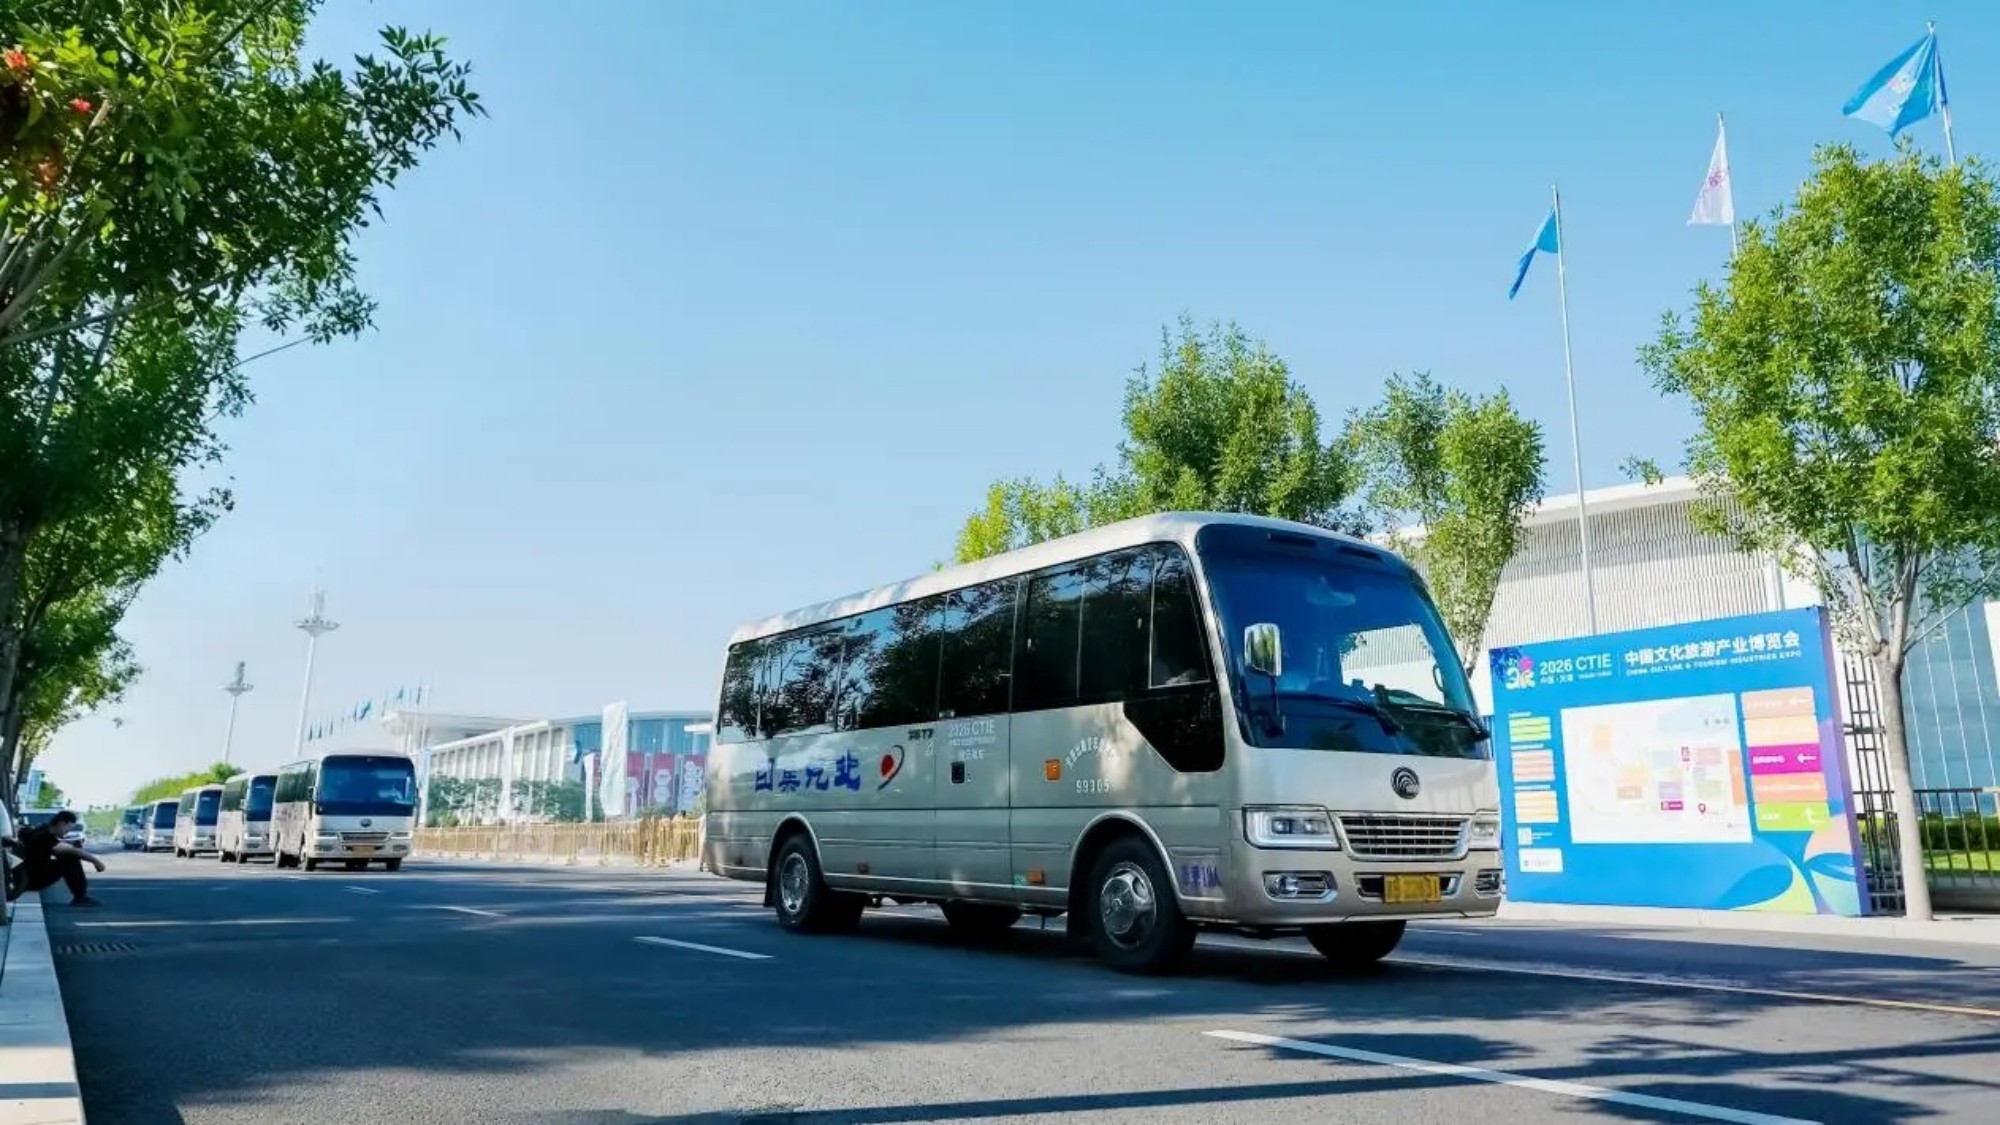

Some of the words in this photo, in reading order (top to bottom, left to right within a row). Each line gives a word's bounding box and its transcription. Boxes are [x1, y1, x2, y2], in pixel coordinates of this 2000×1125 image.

[1624, 630, 1800, 667] 中国文化旅游产业博览会
[1779, 649, 1802, 660] EXPO
[1540, 658, 1573, 675] 2026
[1575, 652, 1612, 671] CTIE
[971, 718, 996, 736] CTIE
